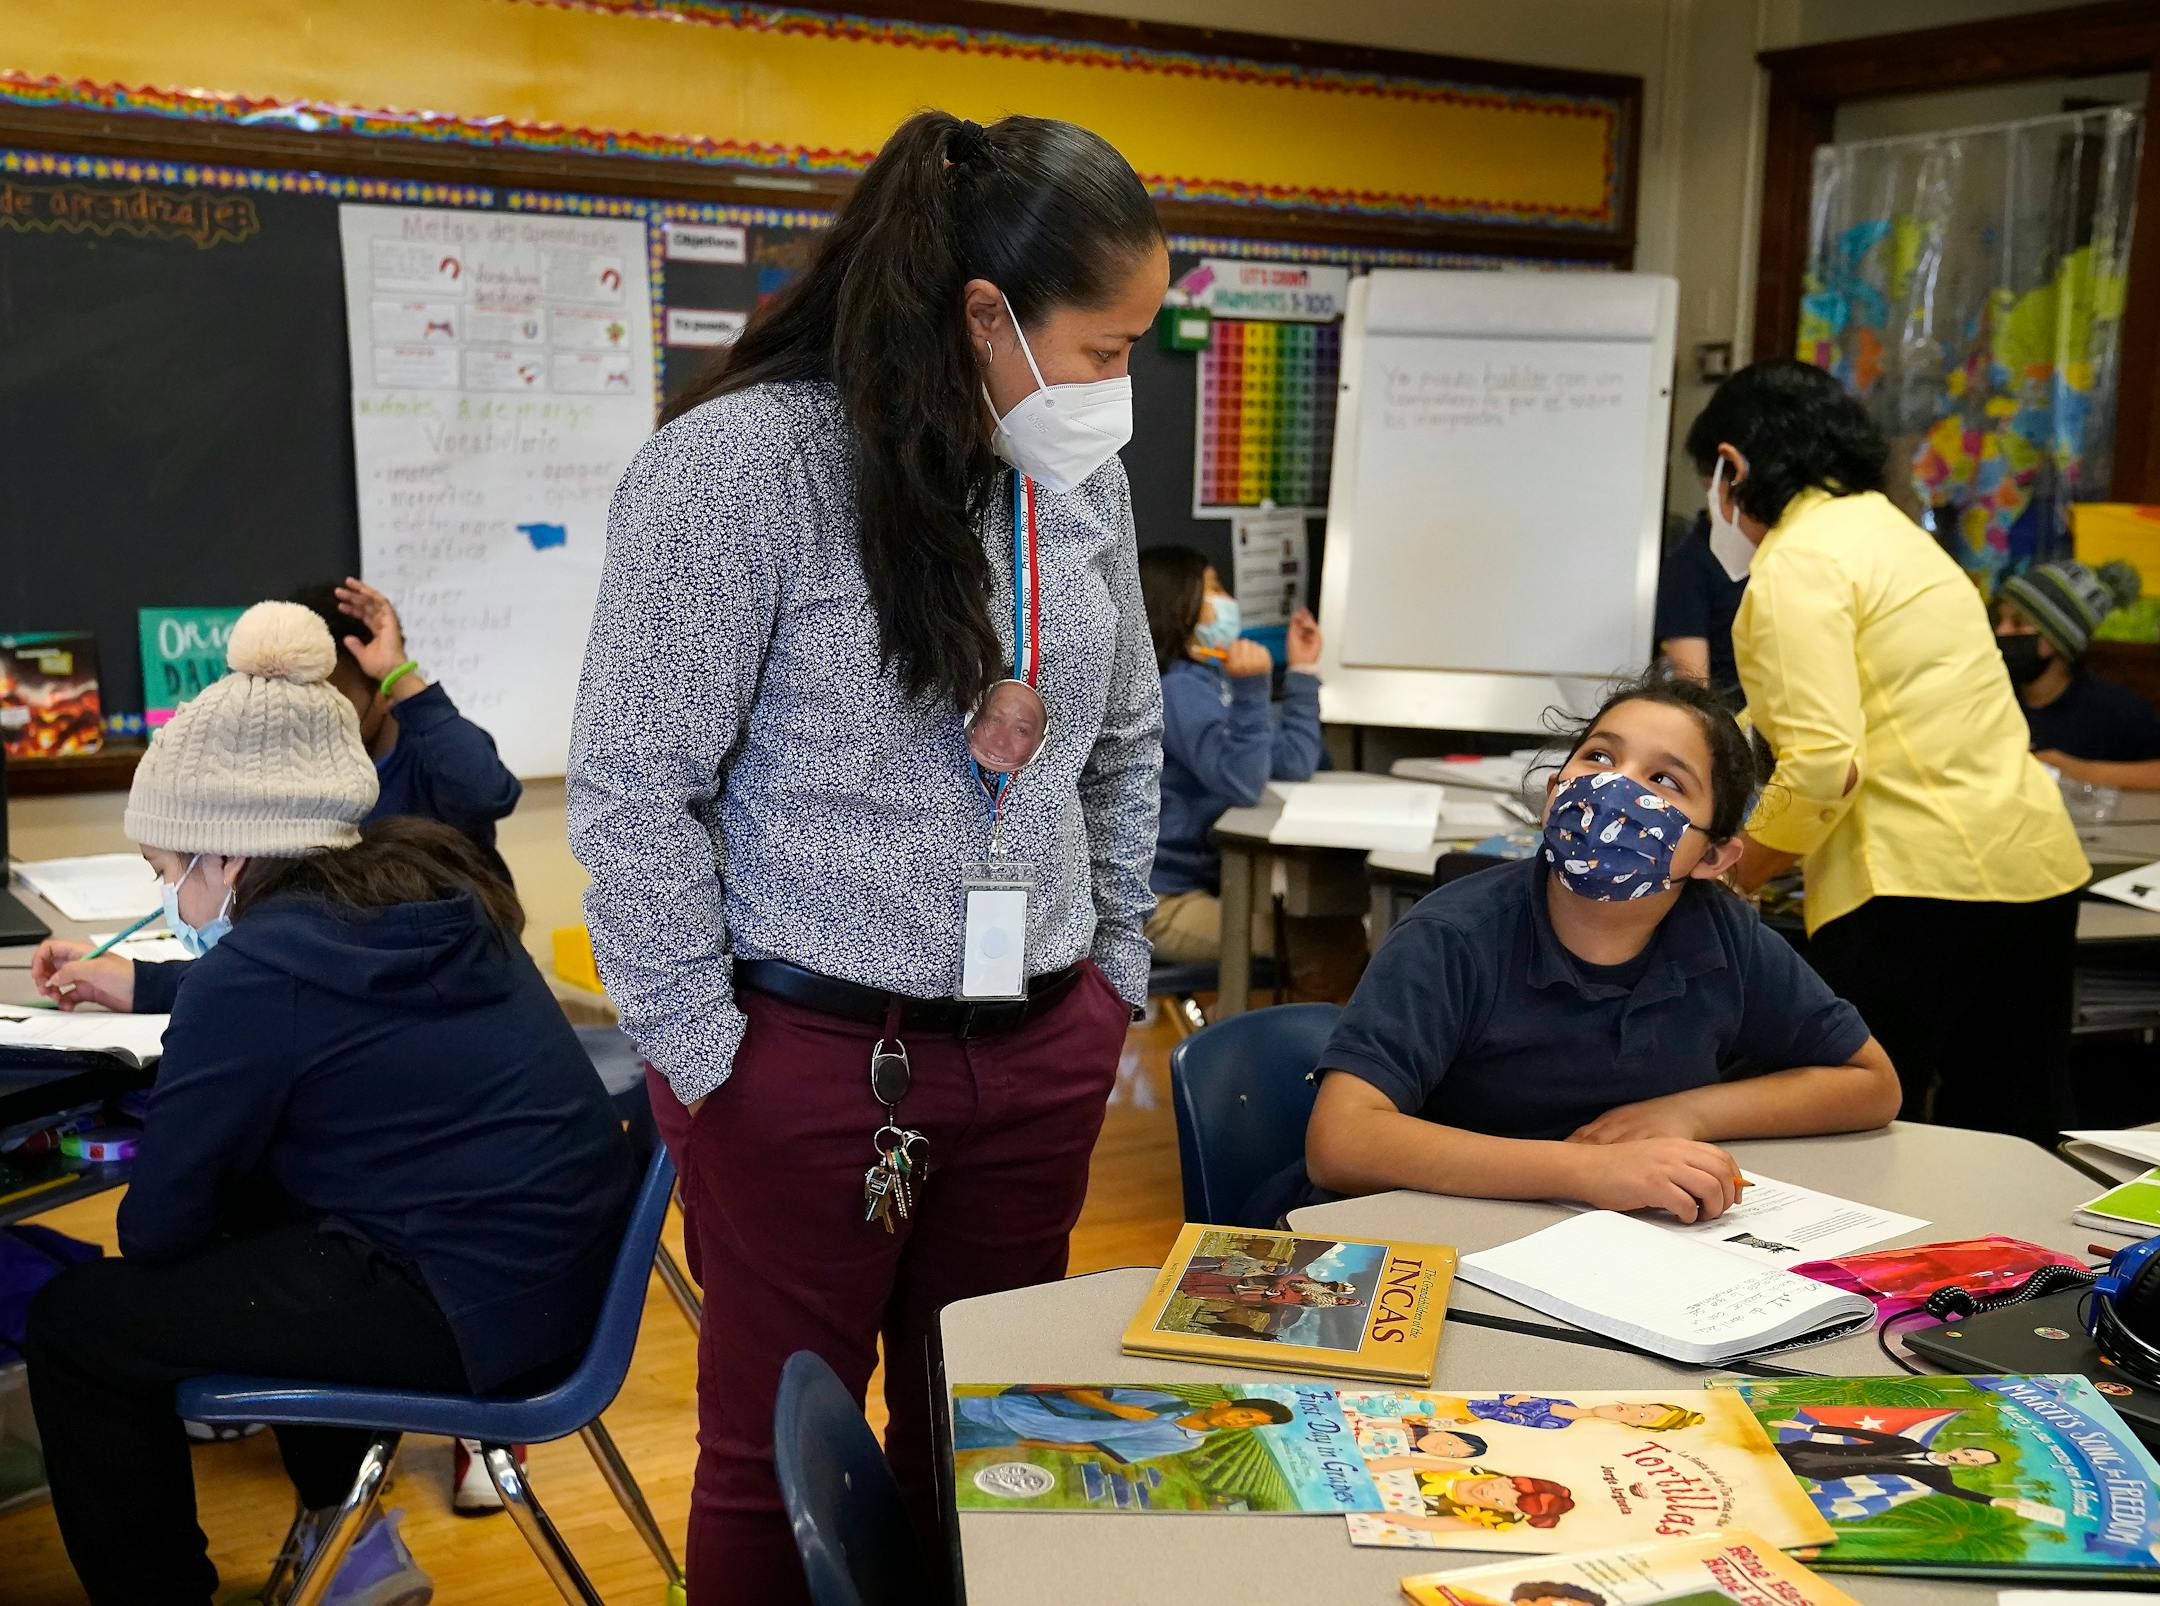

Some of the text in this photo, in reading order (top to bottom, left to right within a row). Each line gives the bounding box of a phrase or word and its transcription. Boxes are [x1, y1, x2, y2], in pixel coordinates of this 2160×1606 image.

[1021, 511, 1030, 570] PUERTO RICO
[1023, 587, 1032, 649] PUERTO RICO
[1371, 1256, 1423, 1343] INCAS
[1295, 1390, 1333, 1417] First
[1305, 1418, 1341, 1444] Day
[1317, 1446, 1344, 1458] in
[1320, 1461, 1359, 1504] Grapes
[1600, 1465, 1619, 1486] Jorge
[1622, 1441, 1719, 1537] Tortillas
[2069, 1430, 2126, 1466] SONG
[2104, 1478, 2148, 1546] FREEDOM
